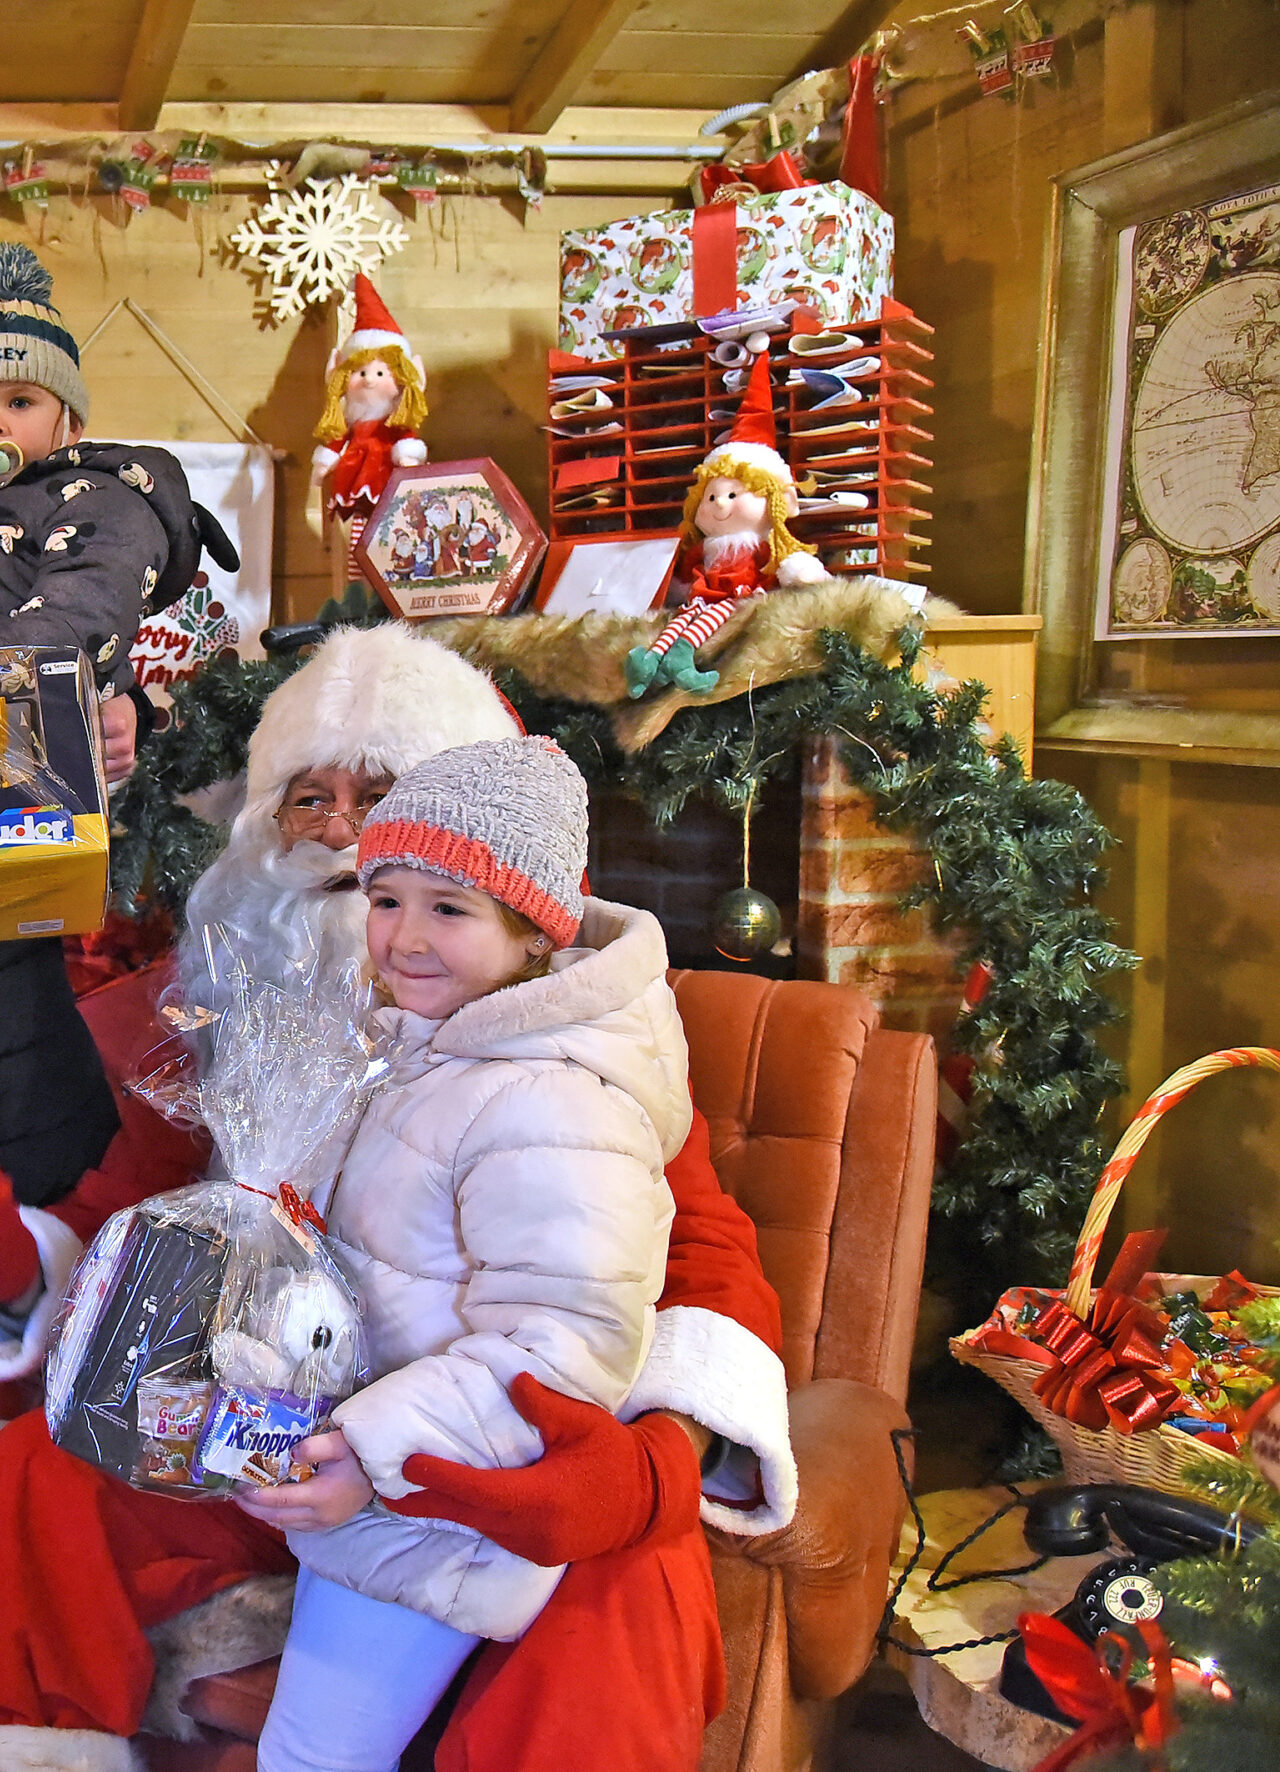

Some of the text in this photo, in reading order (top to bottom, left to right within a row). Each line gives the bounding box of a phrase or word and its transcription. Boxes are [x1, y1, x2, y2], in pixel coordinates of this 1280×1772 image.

[410, 592, 482, 610] MERRY CHRISTMAS
[133, 625, 194, 661] erry
[226, 1420, 311, 1459] Knoppe
